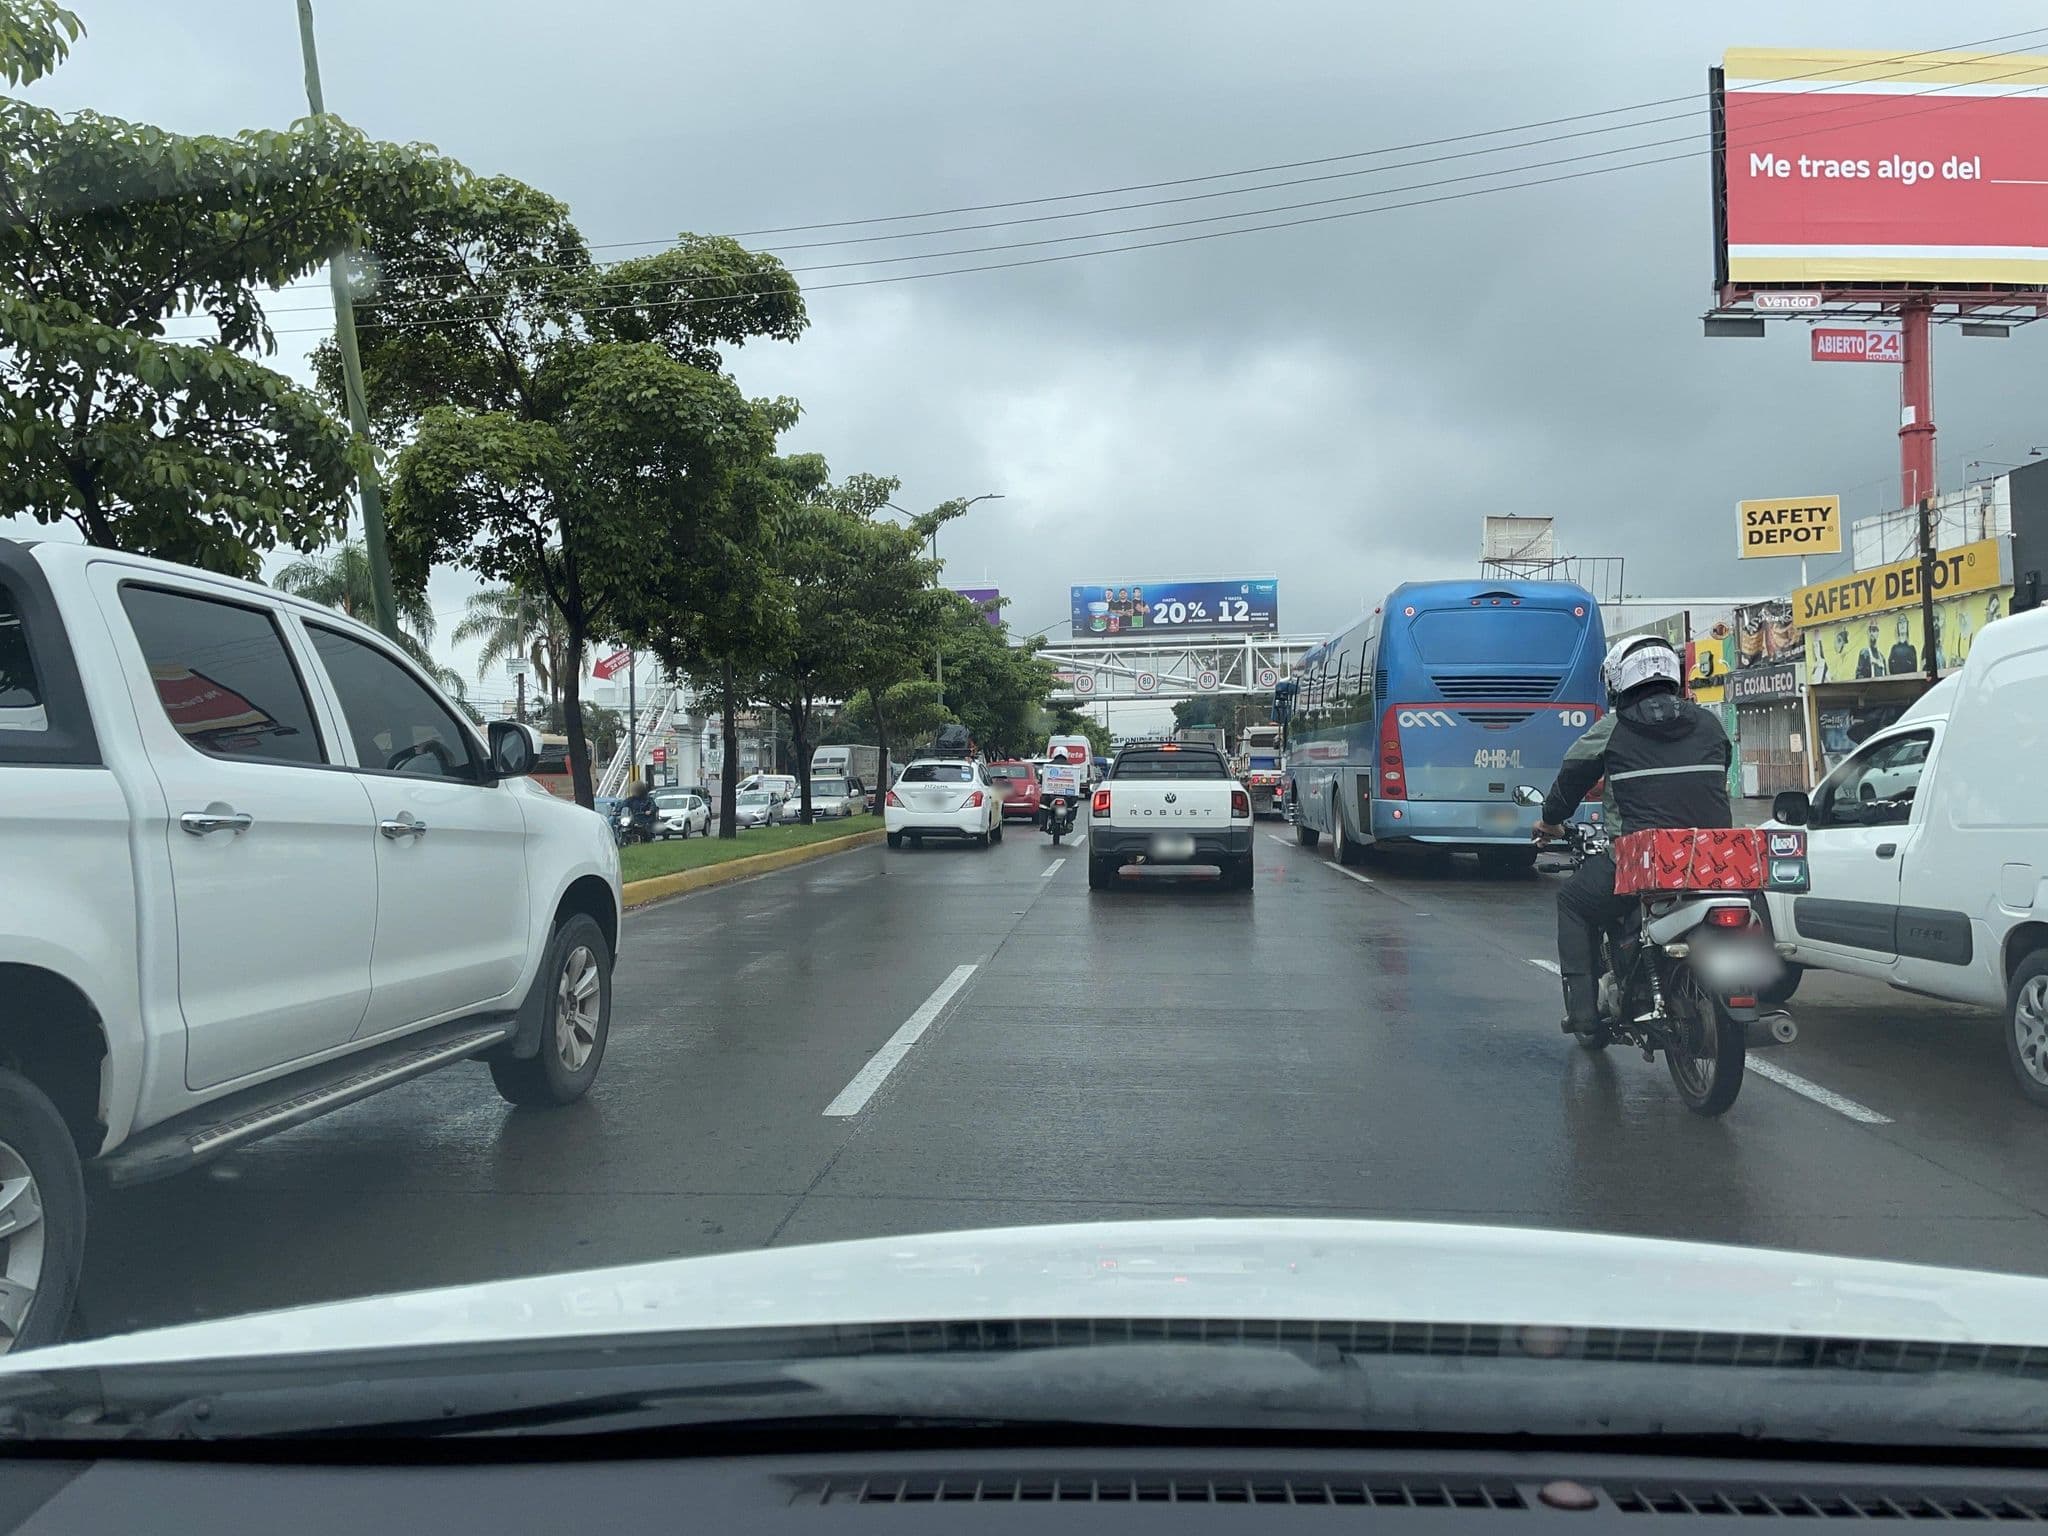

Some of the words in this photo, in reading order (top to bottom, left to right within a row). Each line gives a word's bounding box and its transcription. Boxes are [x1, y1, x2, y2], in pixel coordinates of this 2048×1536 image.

[1749, 153, 1791, 178] Me
[1798, 154, 1871, 179] traes
[1877, 154, 1935, 185] algo
[1941, 156, 1982, 180] del
[1763, 296, 1815, 308] Vendor
[1817, 335, 1865, 354] ABIERTO
[1867, 334, 1899, 353] 24
[1746, 506, 1832, 526] SAFETY
[1748, 526, 1826, 545] DEPOT
[1804, 576, 1877, 619] SAFETY
[1218, 600, 1250, 622] 12
[1080, 678, 1089, 687] 80
[1142, 677, 1151, 686] 80
[1203, 675, 1212, 685] 80
[1264, 672, 1273, 682] 50
[1735, 682, 1743, 697] EL
[1743, 671, 1793, 695] COSALTECO
[1558, 710, 1588, 728] 10
